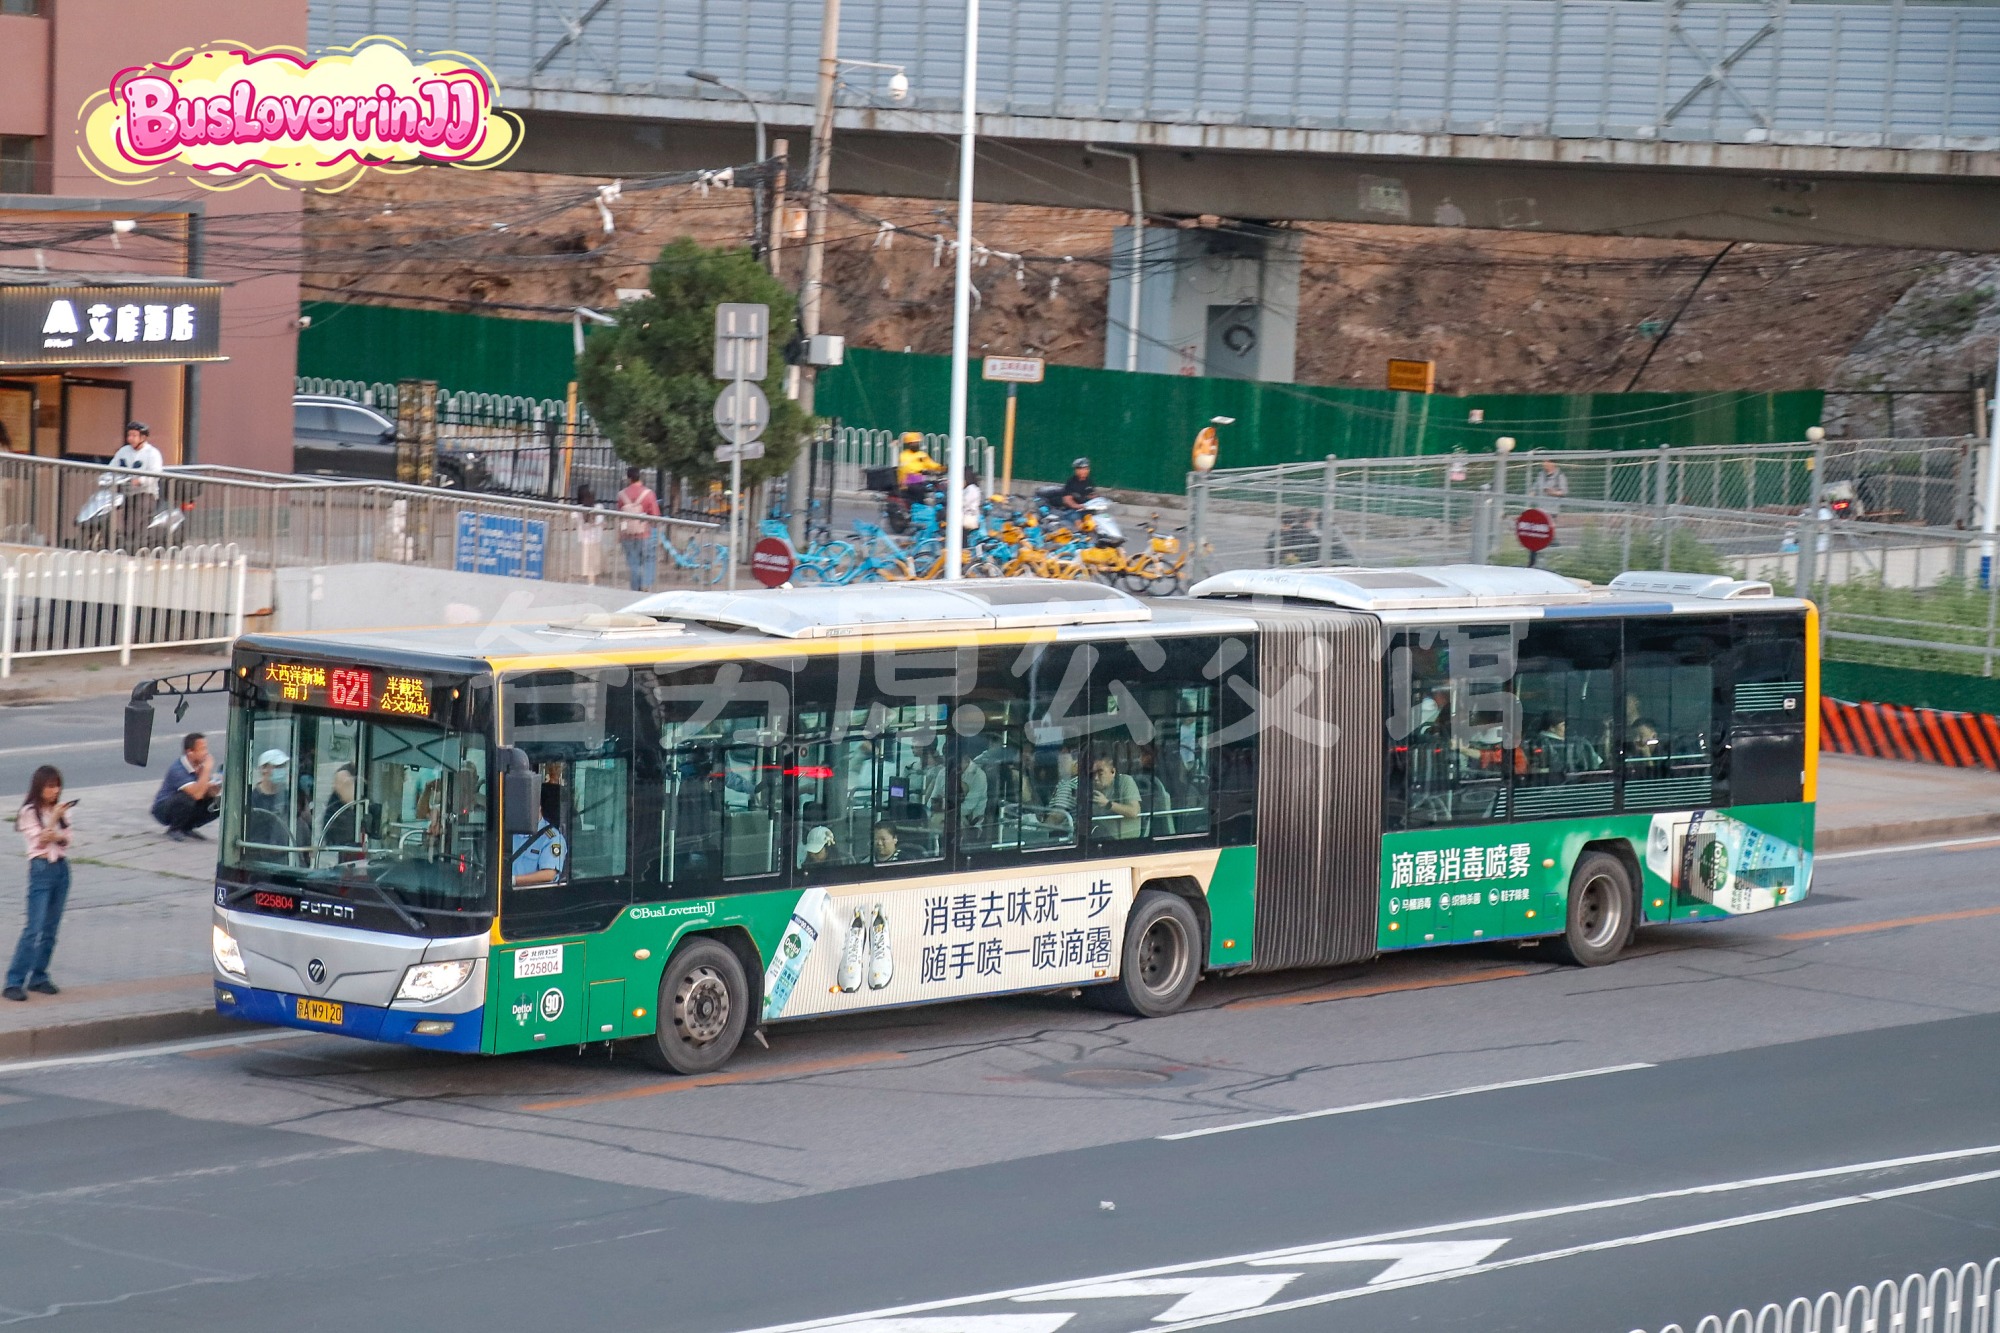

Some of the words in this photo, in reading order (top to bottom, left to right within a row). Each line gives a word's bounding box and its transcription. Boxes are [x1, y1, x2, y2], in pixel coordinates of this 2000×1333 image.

[265, 662, 326, 687] 大西洋新城
[283, 681, 308, 700] 南门
[332, 669, 371, 707] 621
[386, 676, 424, 698] 半截塔
[380, 693, 429, 716] 公交场站
[1390, 842, 1531, 889] 滴露消毒喷雾
[254, 892, 294, 910] 1225804
[300, 900, 355, 920] FOTON
[923, 879, 1114, 936] 消毒去味就一步
[920, 925, 1112, 985] 随手喷一喷滴露
[519, 960, 559, 976] 1225804
[512, 1002, 533, 1015] Dettol
